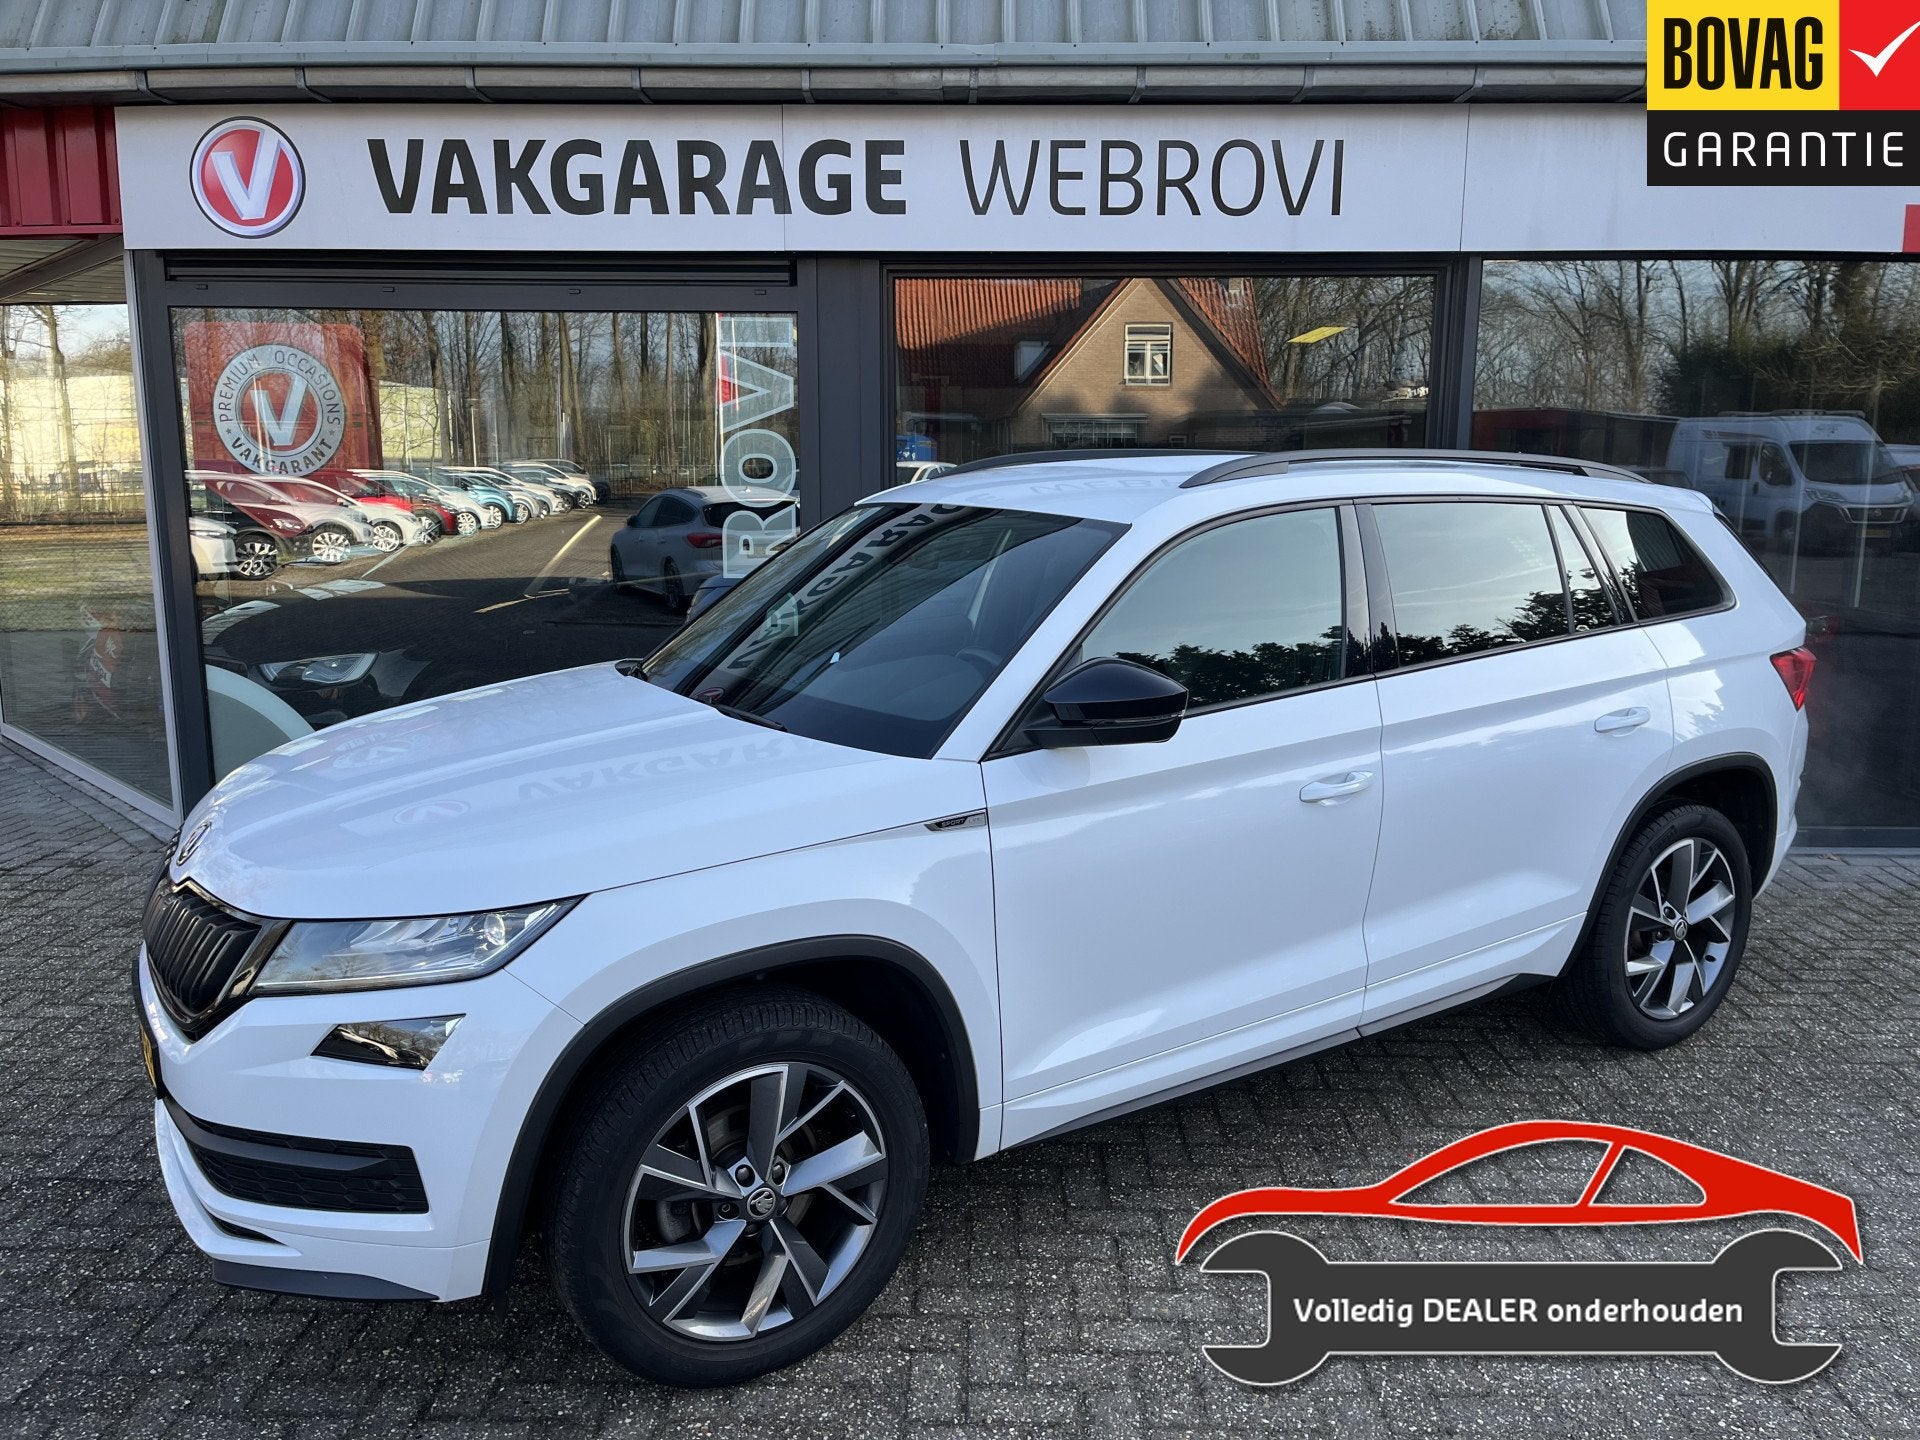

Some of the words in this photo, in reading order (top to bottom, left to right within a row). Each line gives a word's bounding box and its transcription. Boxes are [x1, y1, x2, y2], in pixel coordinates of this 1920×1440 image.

[366, 138, 907, 216] VAKGARAGE
[959, 138, 1345, 217] WEBROVI
[218, 353, 261, 423] PREMIUM
[274, 350, 341, 426] OCCASIONS
[231, 436, 332, 475] VAKGARANT
